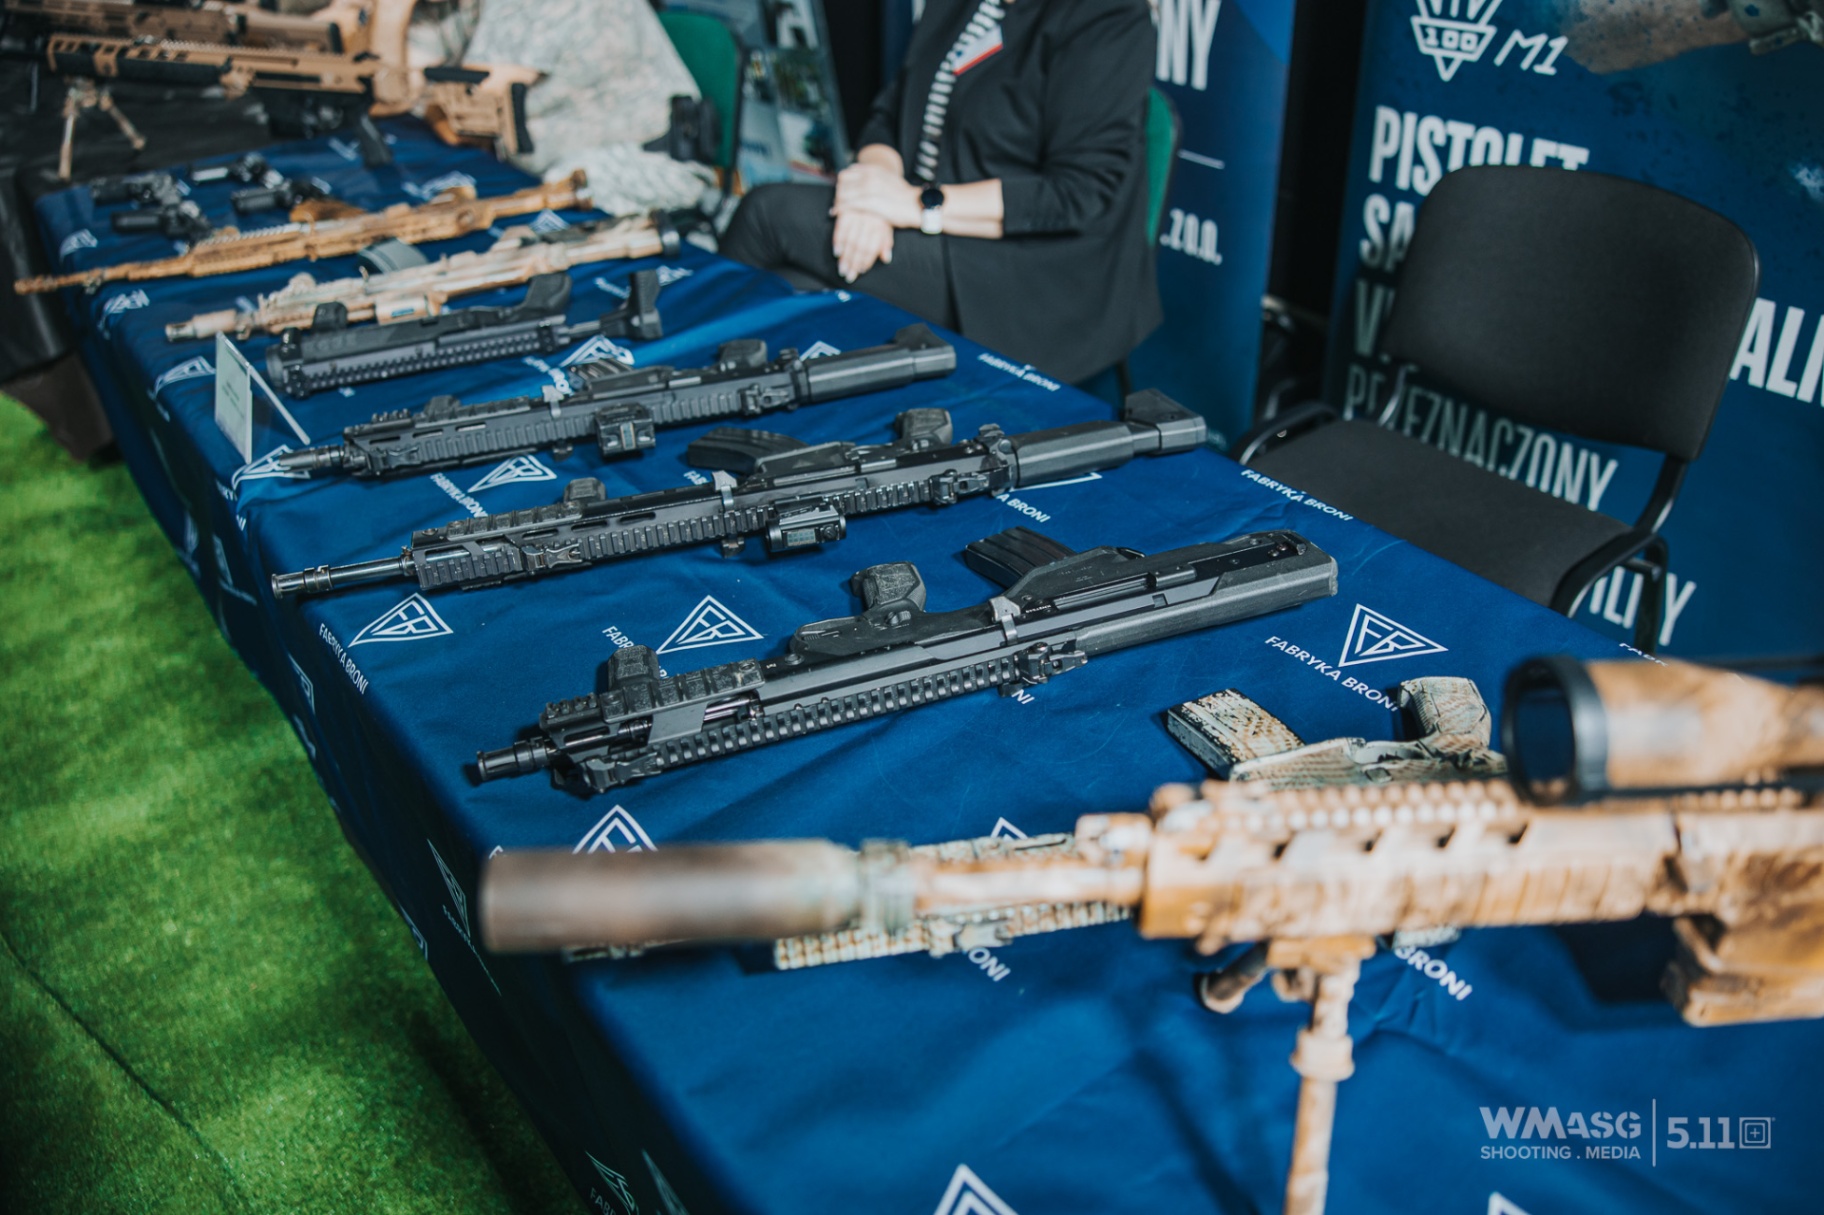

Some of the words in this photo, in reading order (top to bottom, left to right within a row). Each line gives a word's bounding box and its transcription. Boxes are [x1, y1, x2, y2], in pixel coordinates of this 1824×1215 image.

[1424, 26, 1479, 51] 100
[1494, 28, 1568, 76] M1
[1006, 498, 1051, 523] BRONI
[1241, 469, 1304, 502] FABRYKA
[1303, 498, 1354, 521] BRONI
[344, 658, 369, 695] BRONI
[1264, 636, 1342, 681] FABRYKA
